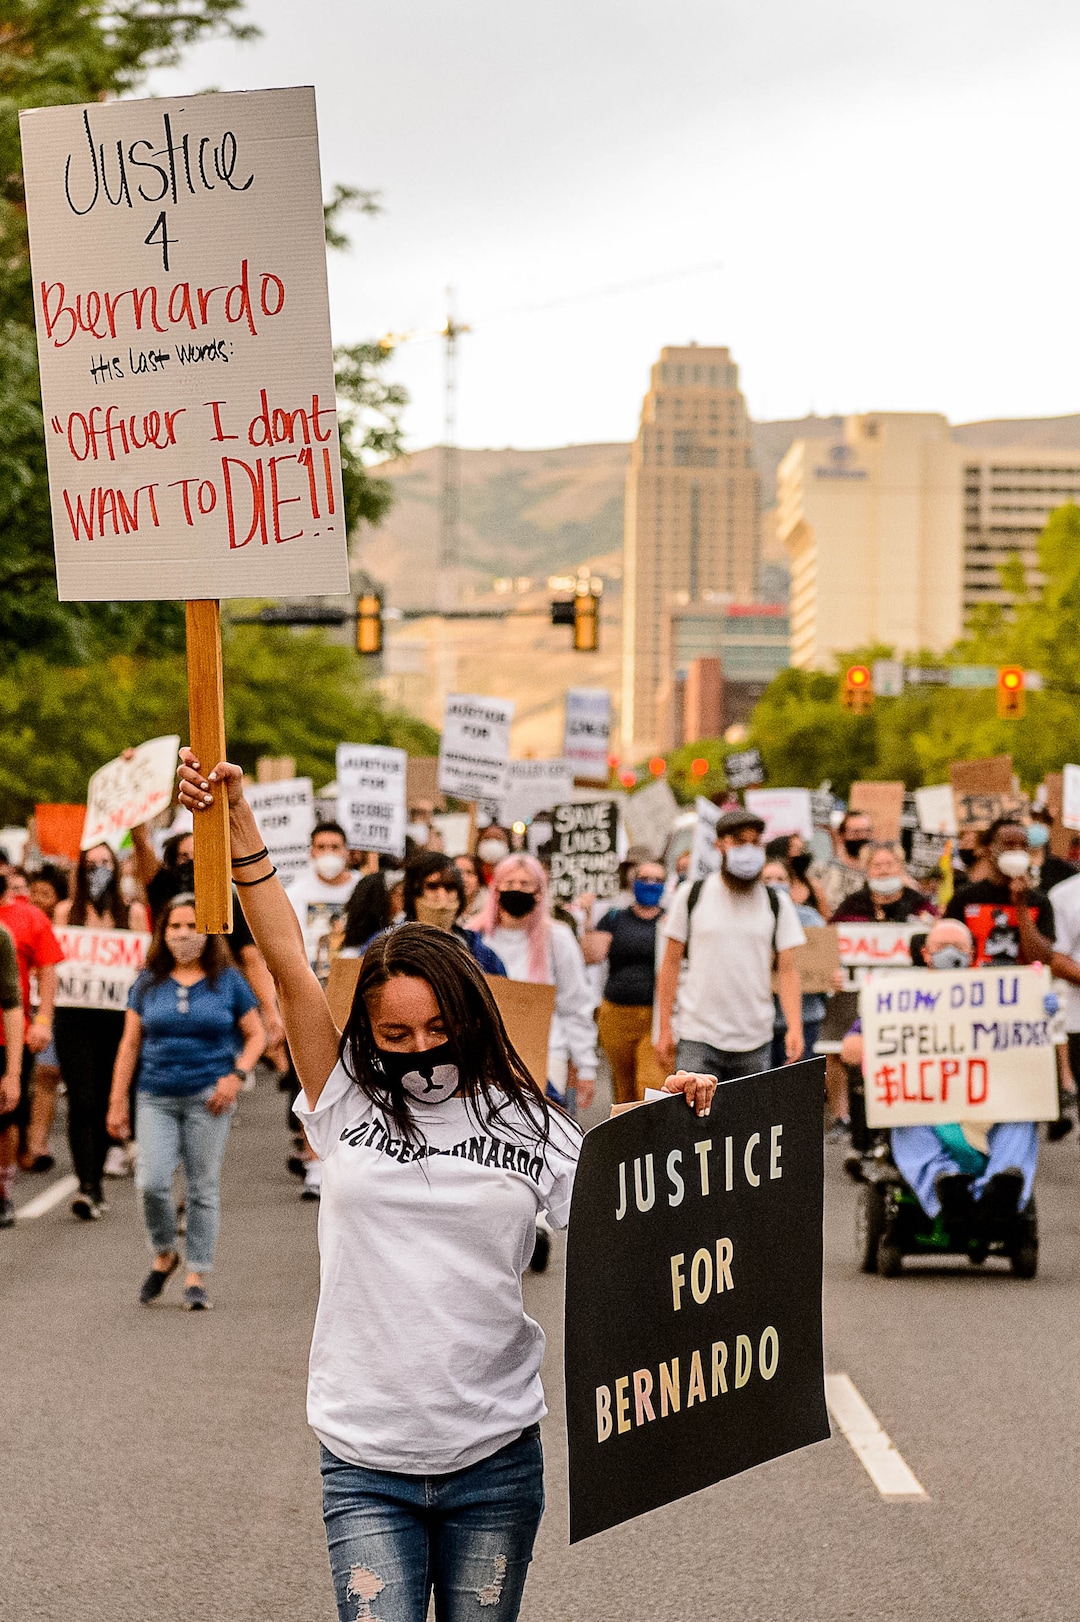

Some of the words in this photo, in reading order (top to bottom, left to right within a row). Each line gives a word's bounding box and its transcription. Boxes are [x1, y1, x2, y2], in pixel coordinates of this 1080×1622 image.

[65, 108, 254, 215] Justice
[144, 211, 179, 271] 4
[40, 259, 285, 348] Bernardo
[90, 354, 124, 384] His
[203, 401, 239, 442] I
[248, 389, 336, 447] dont
[63, 483, 160, 541] WANT
[553, 804, 612, 833] SAVE
[560, 830, 612, 855] LIVES
[60, 935, 143, 968] ACISM
[877, 990, 941, 1014] HOW
[950, 981, 985, 1008] DO
[998, 977, 1019, 1006] U
[877, 1023, 965, 1057] SPELL
[615, 1124, 784, 1221] JUSTICE
[670, 1237, 735, 1312] FOR
[596, 1325, 780, 1444] BERNARDO
